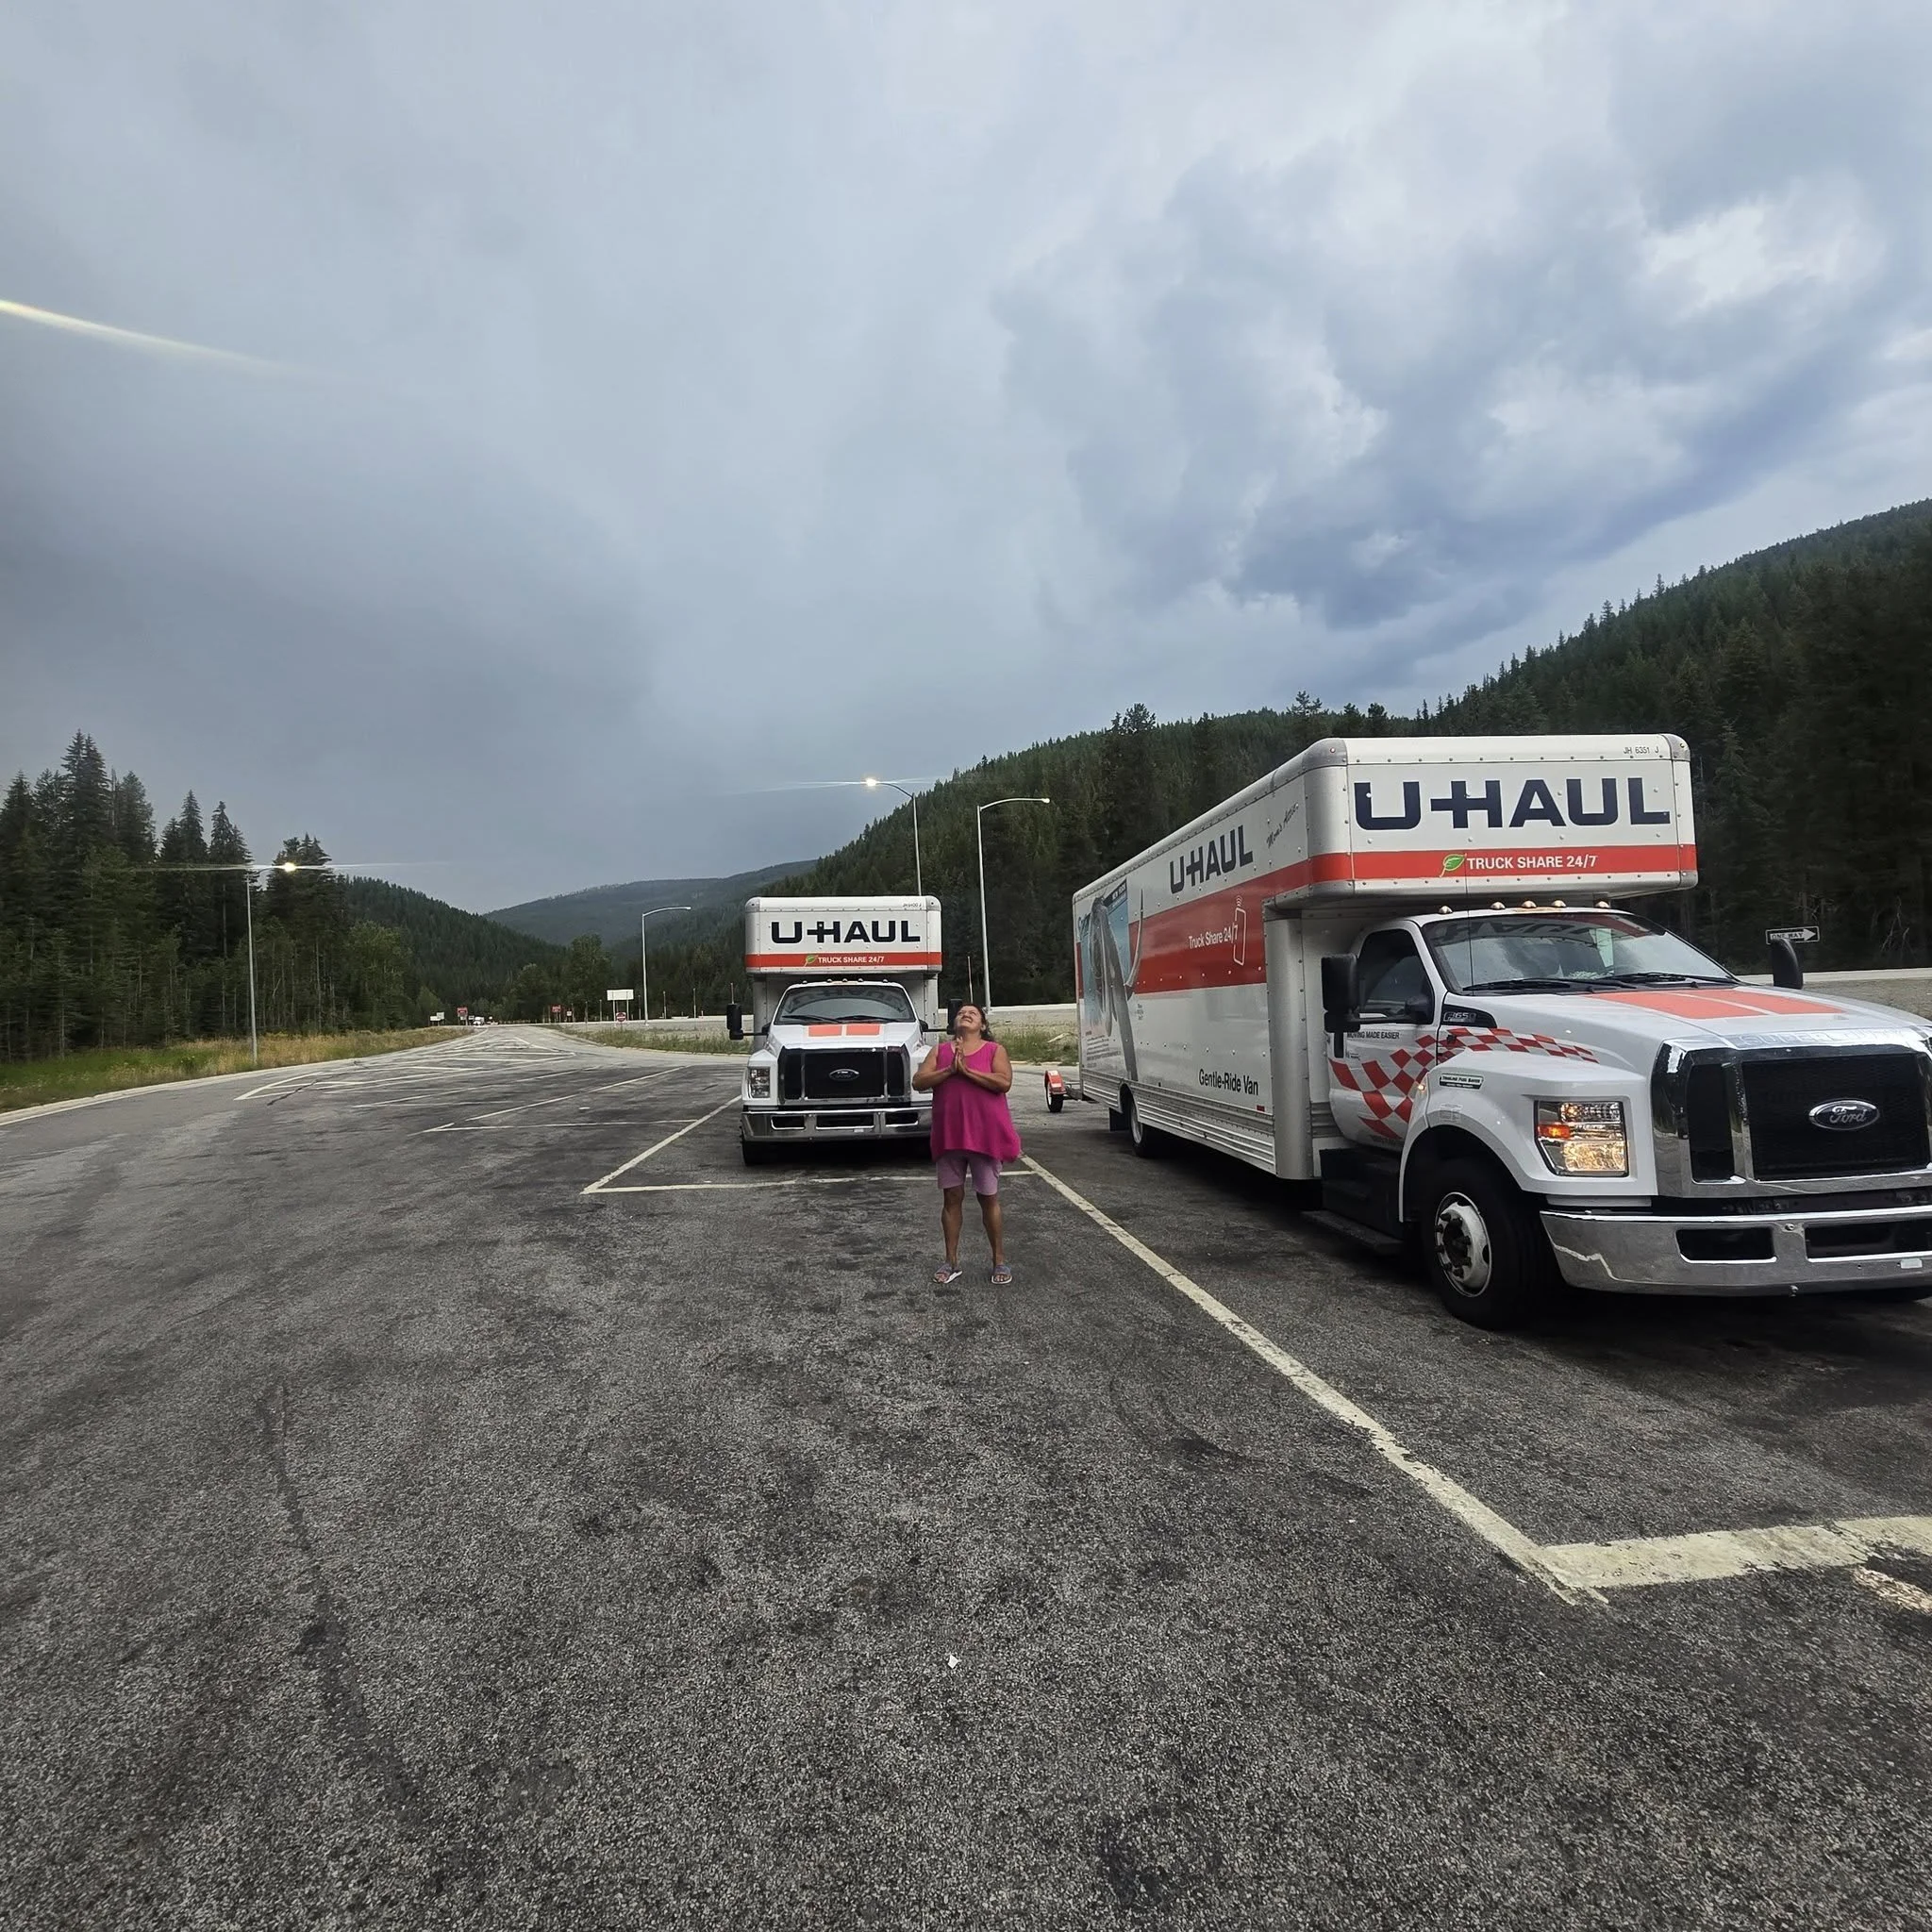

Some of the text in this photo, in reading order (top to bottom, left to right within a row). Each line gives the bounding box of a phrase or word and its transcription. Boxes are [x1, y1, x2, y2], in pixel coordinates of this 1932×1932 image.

[1354, 777, 1671, 830] U-HAUL
[1170, 824, 1254, 894] U-HAUL
[1467, 854, 1598, 869] TRUCK SHARE 24/7
[771, 920, 921, 943] U-HAUL
[1189, 922, 1239, 949] Truck Share 24/7
[1199, 1068, 1259, 1095] Gentle-Ride Van
[1830, 1106, 1867, 1124] Ford
